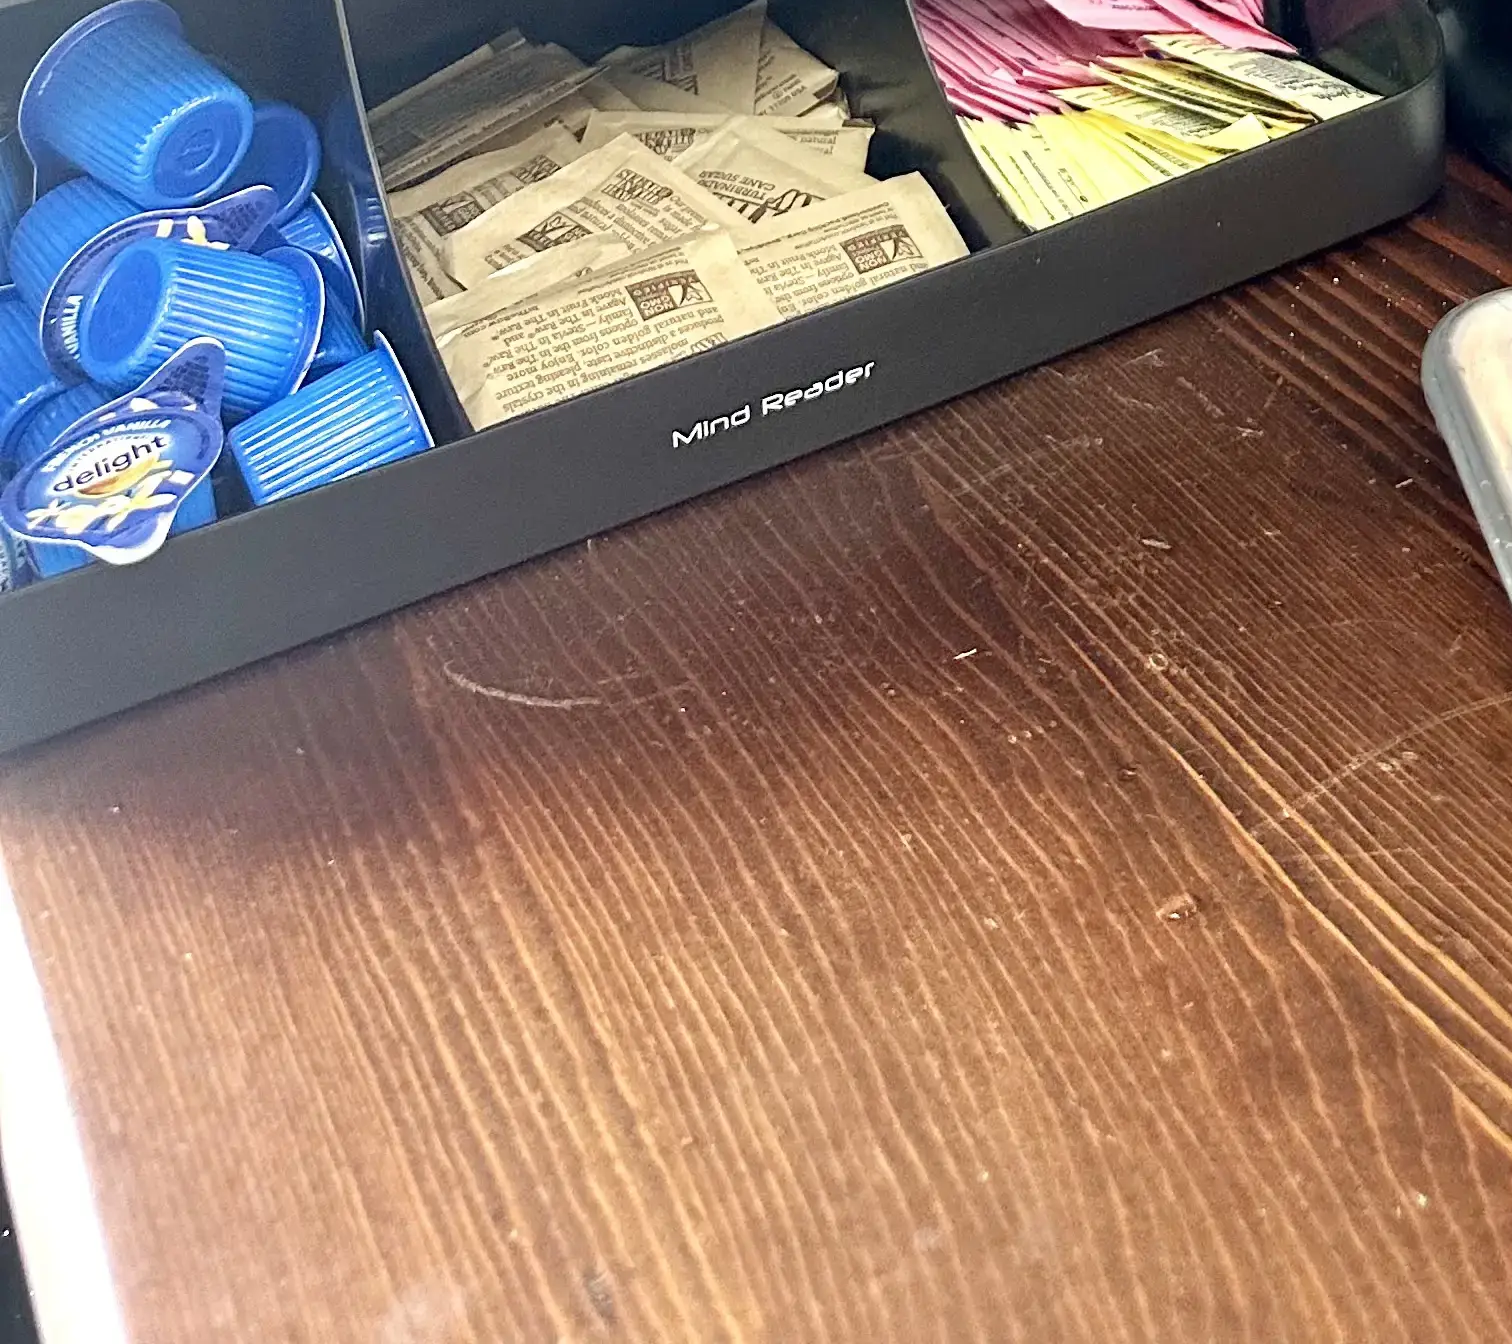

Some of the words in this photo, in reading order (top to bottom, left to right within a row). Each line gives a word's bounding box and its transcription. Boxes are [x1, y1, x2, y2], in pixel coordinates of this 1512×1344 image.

[738, 175, 776, 192] CANE
[579, 205, 613, 235] natural
[656, 215, 685, 240] sugar
[854, 247, 883, 264] GMO
[857, 254, 886, 272] NON
[778, 264, 801, 280] The
[815, 258, 850, 282] family
[868, 263, 908, 286] natural
[817, 269, 855, 291] options
[830, 275, 868, 299] golden
[638, 292, 669, 310] GMO
[792, 283, 818, 300] from
[546, 308, 560, 319] In
[560, 298, 589, 316] Fruit
[580, 307, 594, 319] In
[597, 304, 634, 328] family
[642, 299, 672, 318] NON
[696, 302, 718, 318] and
[523, 312, 547, 329] The
[557, 312, 581, 328] The
[597, 314, 639, 339] options
[653, 309, 695, 334] natural
[502, 331, 526, 347] and
[537, 335, 551, 347] In
[550, 322, 586, 343] Stevia
[572, 330, 599, 349] from
[611, 323, 653, 349] golden
[513, 339, 538, 356] The
[538, 347, 552, 359] In
[551, 340, 572, 357] the
[612, 332, 670, 362] distinctive
[638, 337, 689, 364] molasses
[515, 352, 539, 369] The
[539, 350, 575, 373] Enjoy
[579, 353, 637, 384] remaining
[505, 363, 538, 382] more
[534, 359, 582, 389] pleasing
[494, 378, 536, 401] texture
[545, 382, 566, 398] the
[565, 376, 580, 390] in
[501, 388, 545, 414] crystals
[672, 404, 751, 448] Mind
[762, 361, 875, 415] Reader
[102, 419, 171, 435] VANILLA
[53, 435, 167, 492] delight
